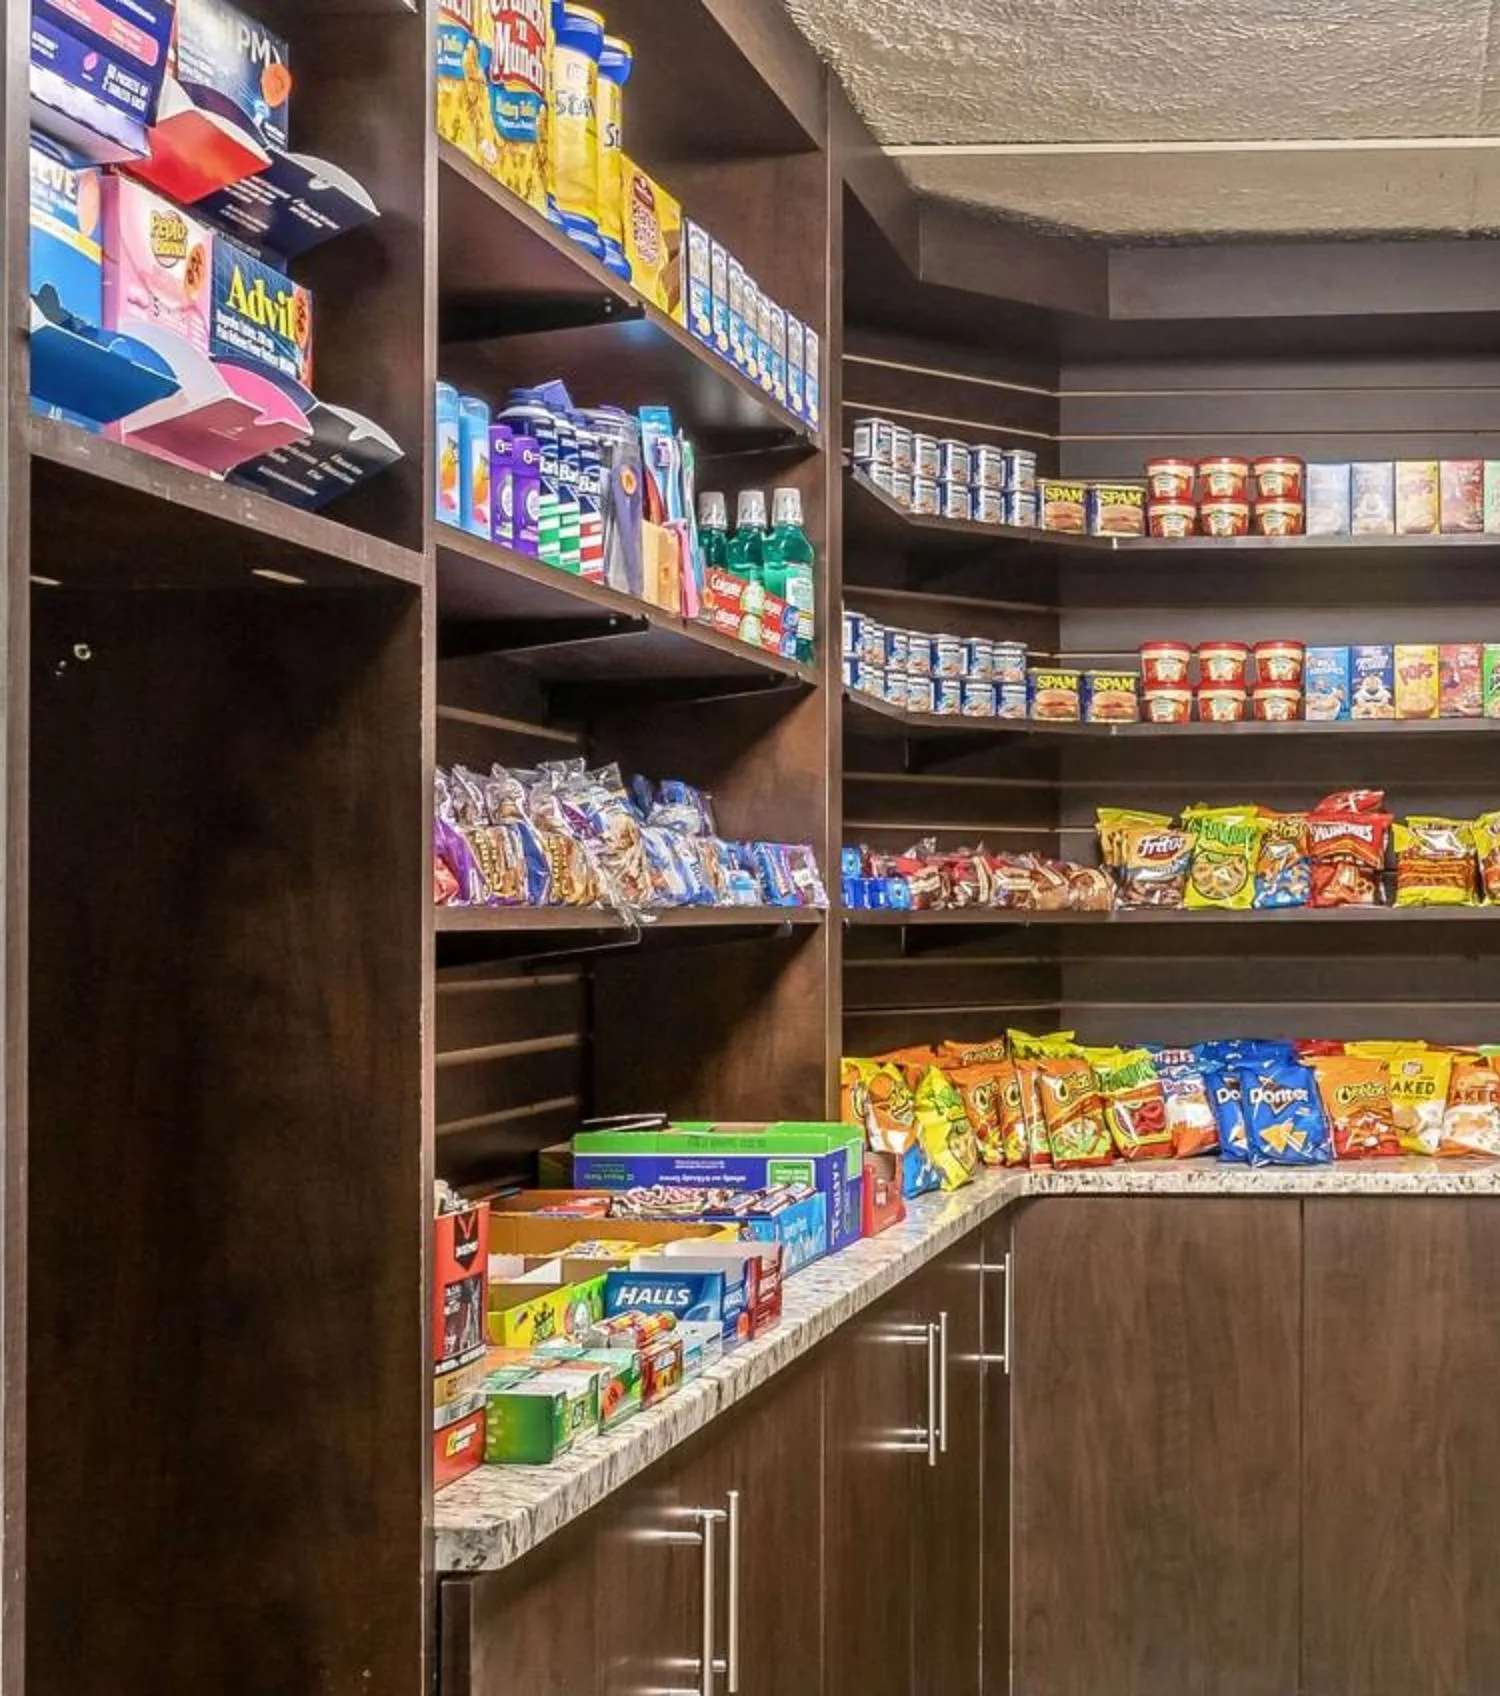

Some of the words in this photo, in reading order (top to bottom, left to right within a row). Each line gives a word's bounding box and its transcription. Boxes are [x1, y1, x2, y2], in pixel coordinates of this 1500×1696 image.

[225, 264, 297, 343] Advil
[1044, 485, 1084, 502] SPAM
[1100, 488, 1143, 506] SPAM
[1037, 675, 1077, 690] SPAM
[1094, 675, 1136, 691] SPAM
[1399, 662, 1435, 686] POPS
[1311, 822, 1374, 843] MUNCHIES
[1139, 834, 1185, 856] Fritos
[1250, 1087, 1309, 1105] Doritos
[1391, 1080, 1436, 1095] AKED
[614, 1286, 691, 1307] HALLS
